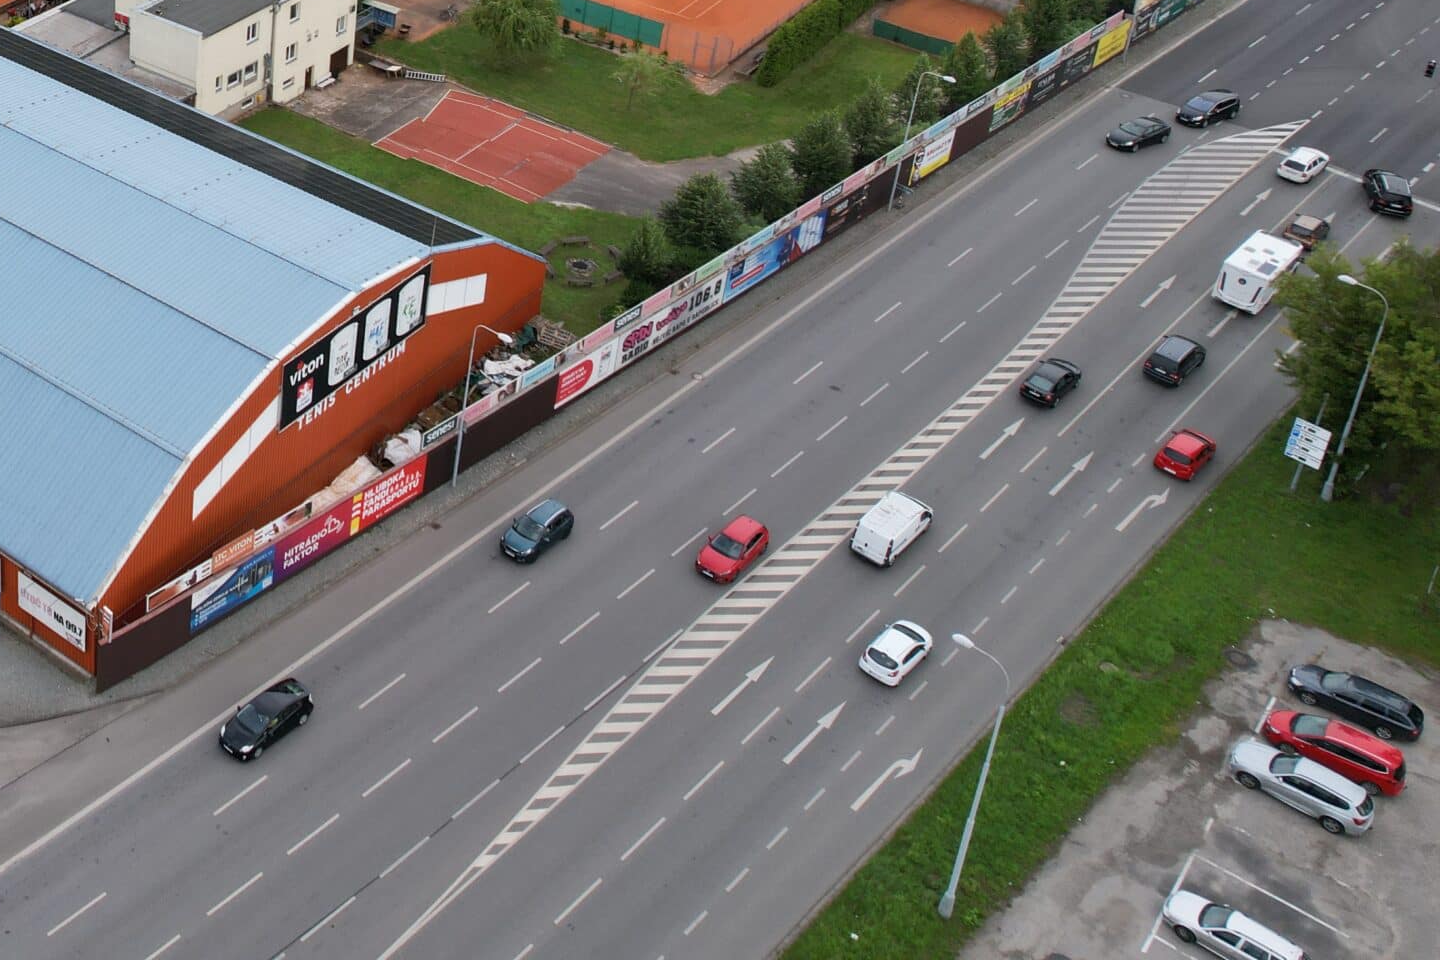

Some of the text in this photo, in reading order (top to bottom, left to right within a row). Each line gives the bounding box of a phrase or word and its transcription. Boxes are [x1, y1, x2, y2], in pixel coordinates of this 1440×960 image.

[289, 353, 324, 386] viton
[297, 391, 336, 430] TENIS
[345, 339, 406, 394] CENTRUM
[426, 420, 456, 443] senesi
[283, 542, 319, 570] FAKTOR
[284, 527, 328, 559] HITRÁDIO
